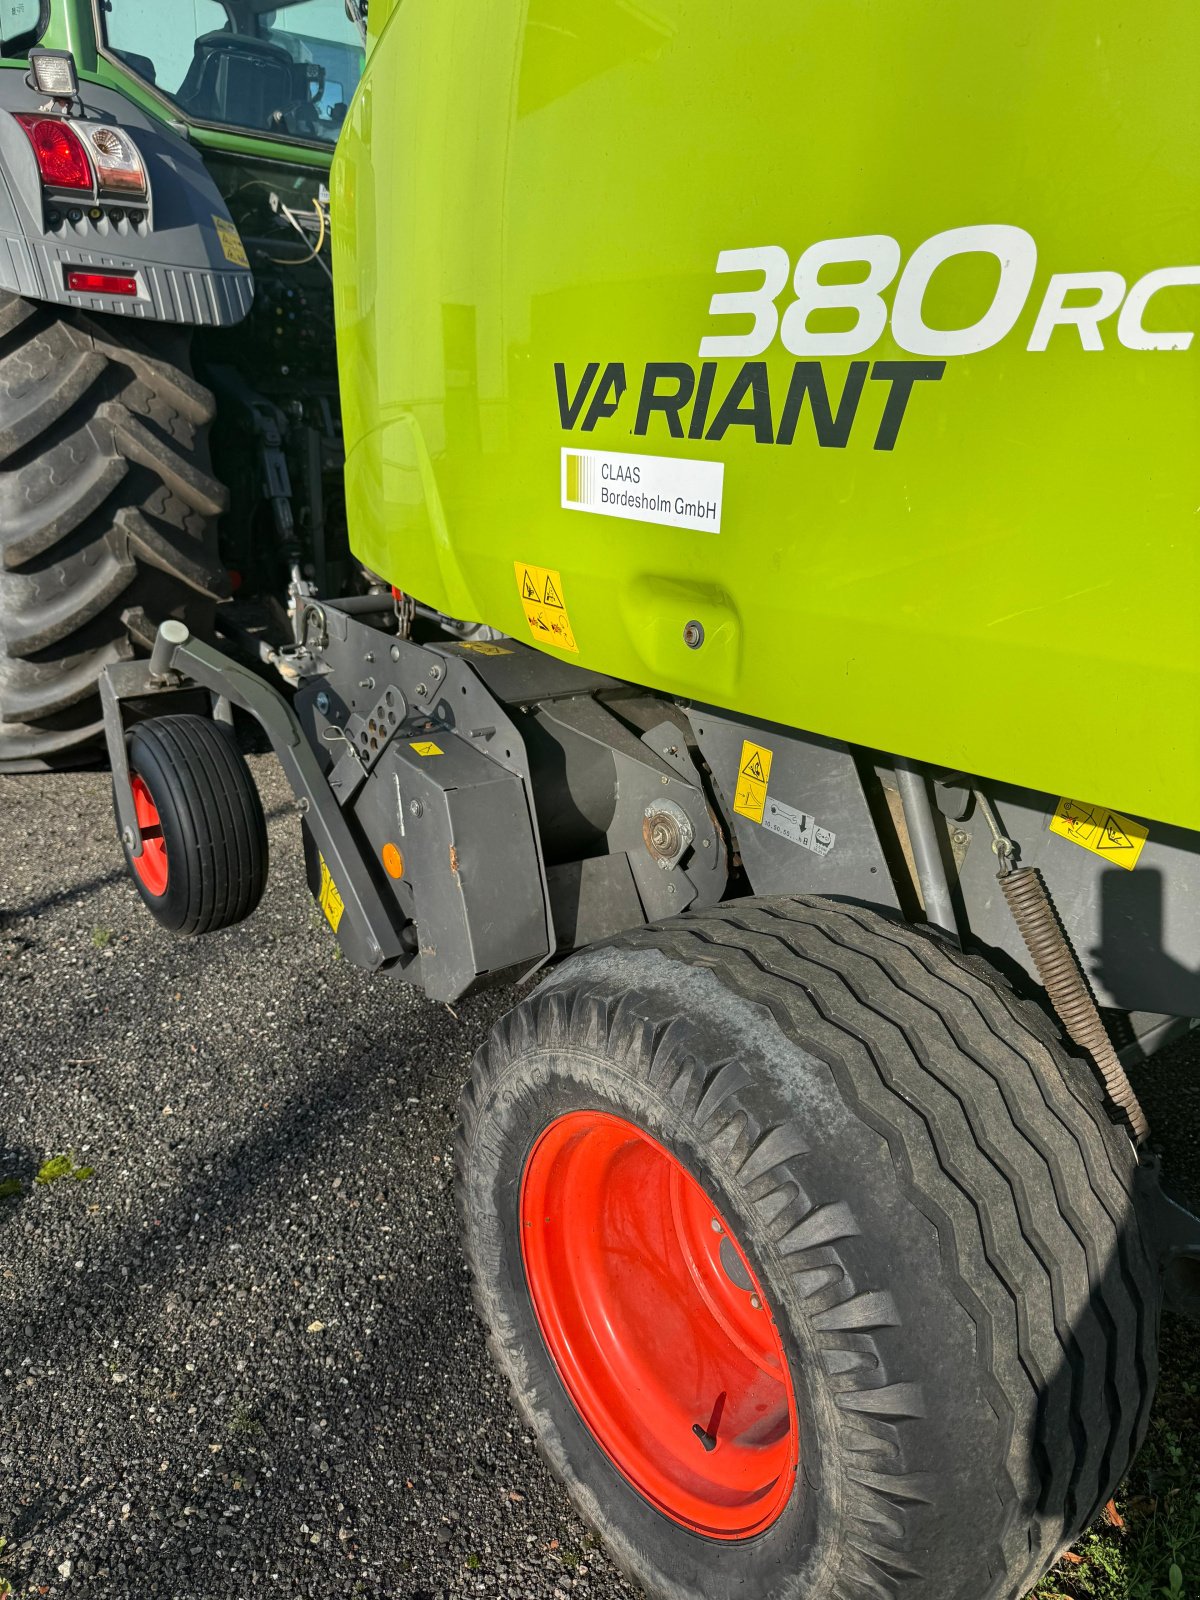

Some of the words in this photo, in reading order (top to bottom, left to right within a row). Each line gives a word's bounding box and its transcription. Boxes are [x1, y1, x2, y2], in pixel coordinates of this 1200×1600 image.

[698, 224, 1038, 357] 380
[1026, 265, 1200, 352] RC
[553, 360, 947, 452] VARIANT
[601, 463, 641, 484] CLAAS
[601, 487, 672, 513] Bordesholm
[674, 497, 717, 520] GmbH
